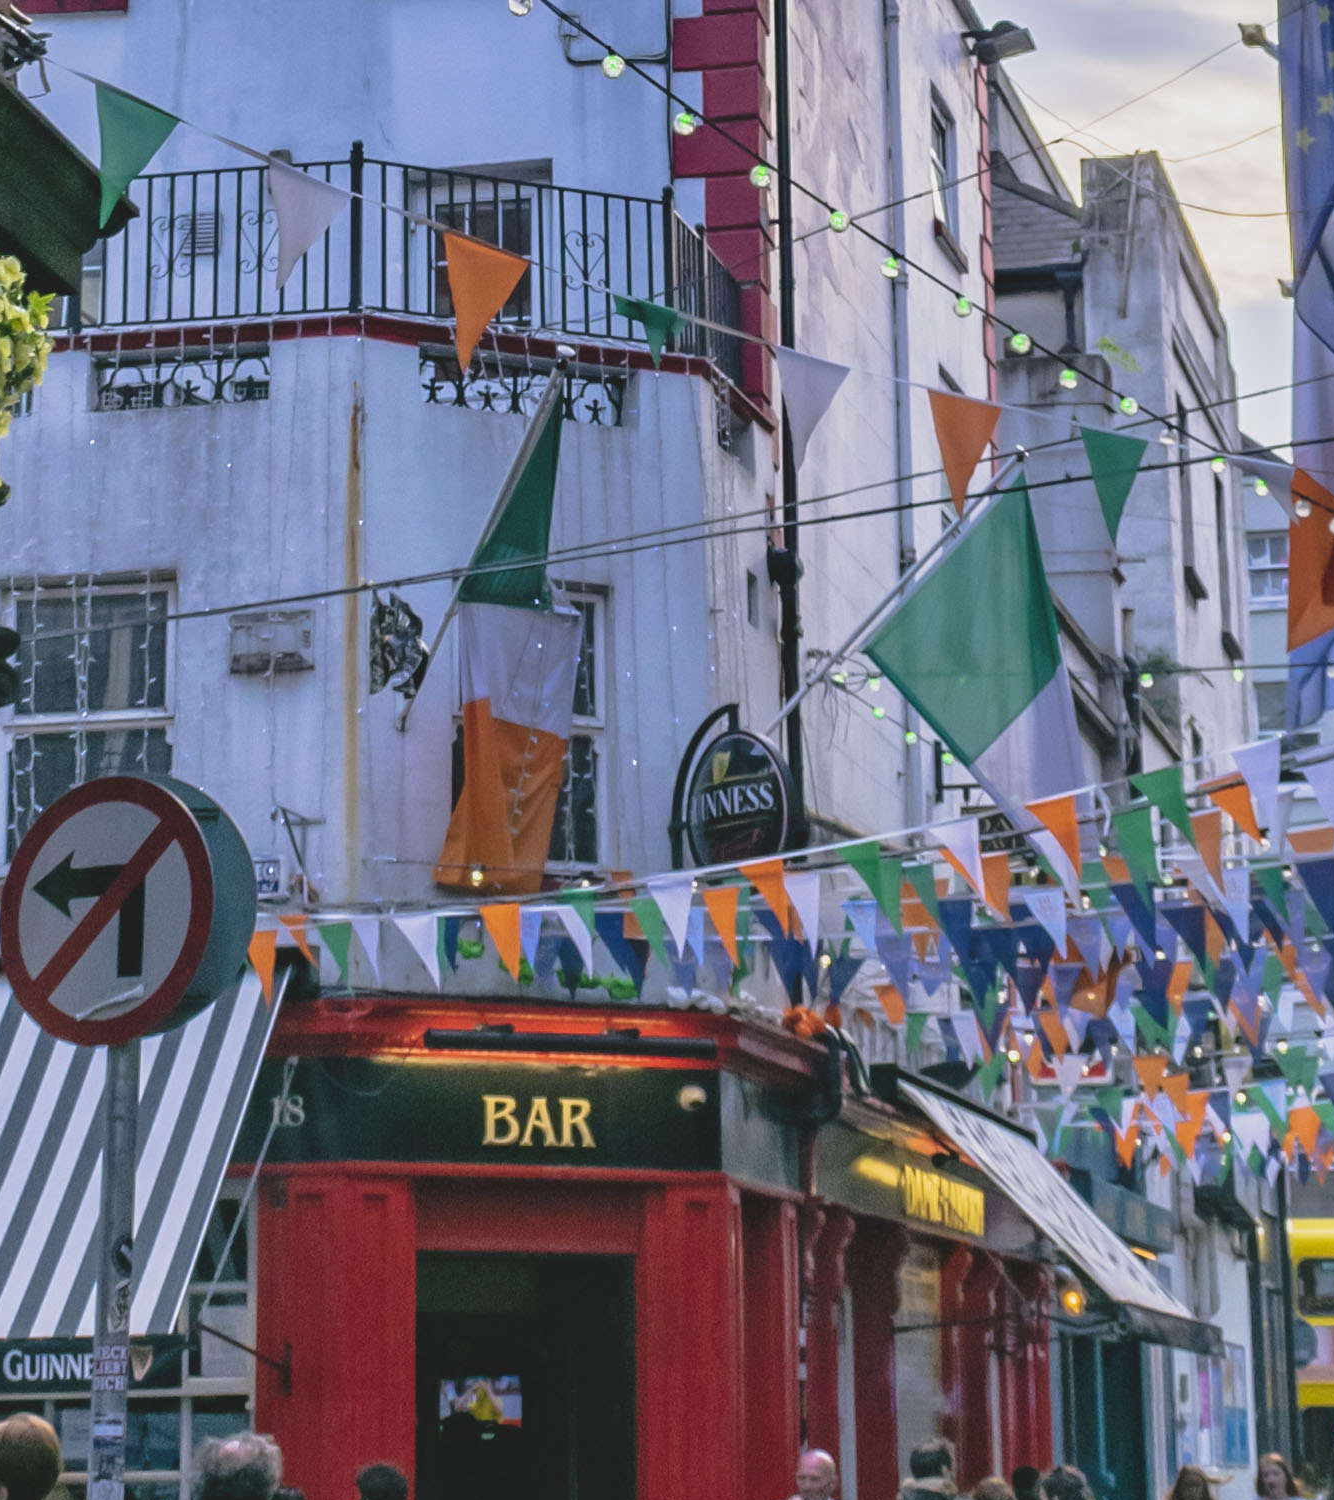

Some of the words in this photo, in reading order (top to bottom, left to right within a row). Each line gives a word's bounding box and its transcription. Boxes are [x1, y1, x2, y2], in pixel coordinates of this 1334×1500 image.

[272, 1095, 306, 1128] 18
[481, 1094, 596, 1148] BAR
[2, 1348, 95, 1383] GUINNE
